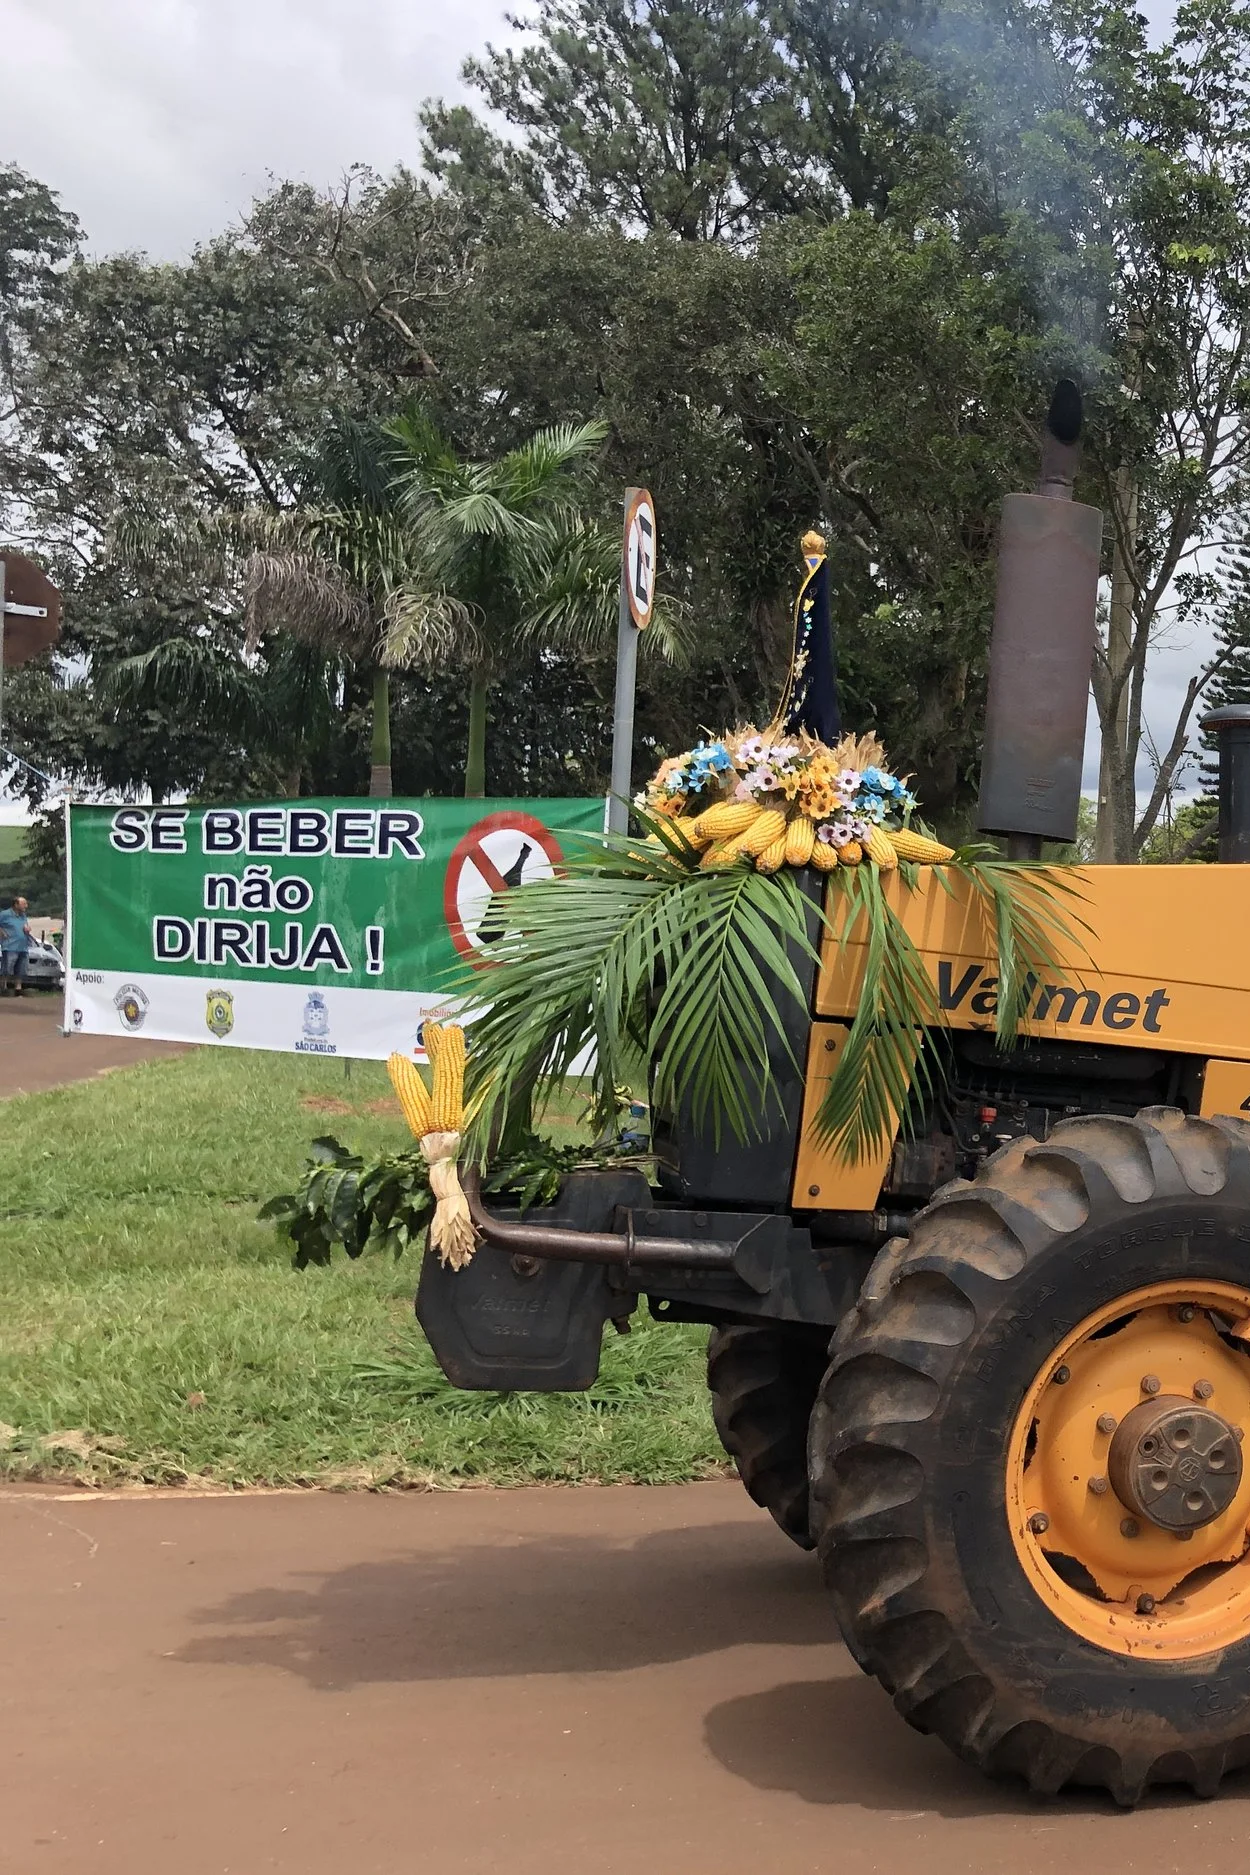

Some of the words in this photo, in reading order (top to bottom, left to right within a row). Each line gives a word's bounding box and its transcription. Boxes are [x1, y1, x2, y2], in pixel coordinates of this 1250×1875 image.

[110, 808, 189, 853] SE
[202, 808, 425, 859] BEBER
[204, 864, 313, 912] não
[153, 916, 352, 973] DIRIJA
[366, 926, 384, 975] !
[76, 971, 105, 985] Apoio:
[938, 961, 1171, 1033] Valmet
[295, 1041, 309, 1051] SÃO
[309, 1043, 337, 1053] CARLOS
